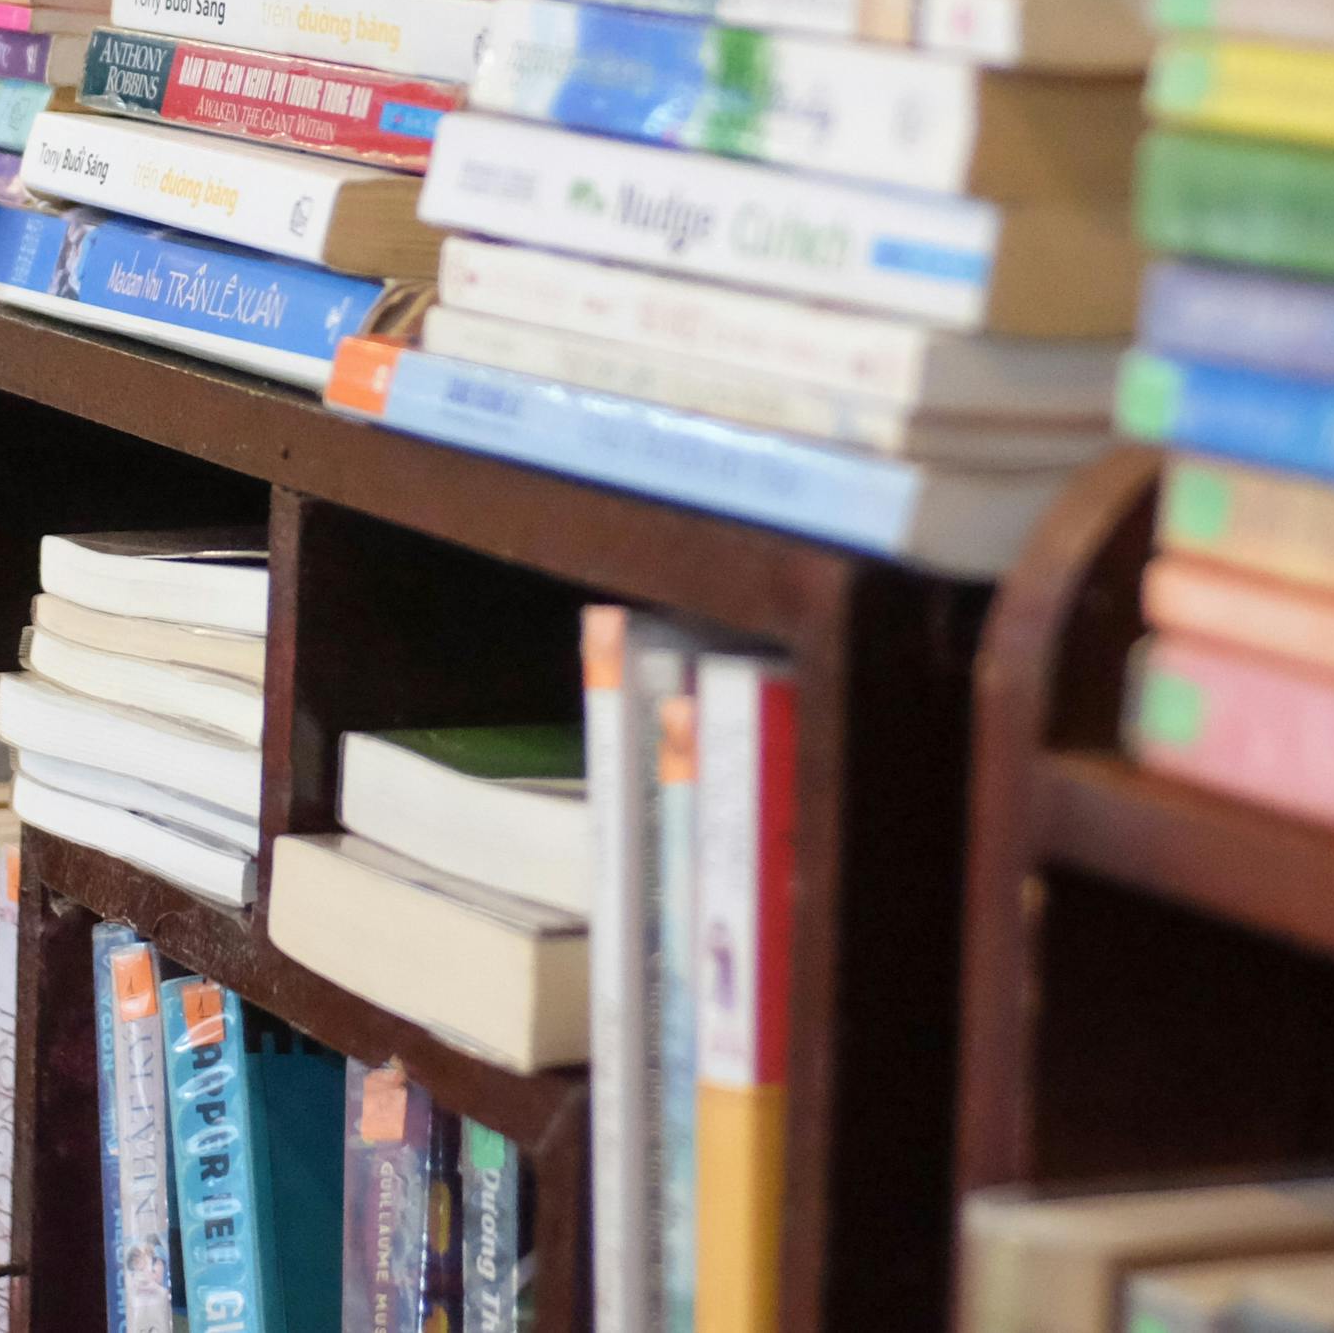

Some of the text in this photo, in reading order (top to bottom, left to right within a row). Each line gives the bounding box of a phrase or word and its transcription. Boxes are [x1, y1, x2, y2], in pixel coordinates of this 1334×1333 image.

[99, 41, 167, 71] ANTHONY
[105, 65, 160, 101] ROBBINS
[195, 95, 240, 125] AWAKEN
[260, 106, 297, 135] GIANT
[296, 111, 338, 142] WITHIN
[39, 142, 109, 185] Tony Buổi Sáng
[231, 281, 289, 330] XUÂN
[373, 1161, 395, 1282] GUILLAUME
